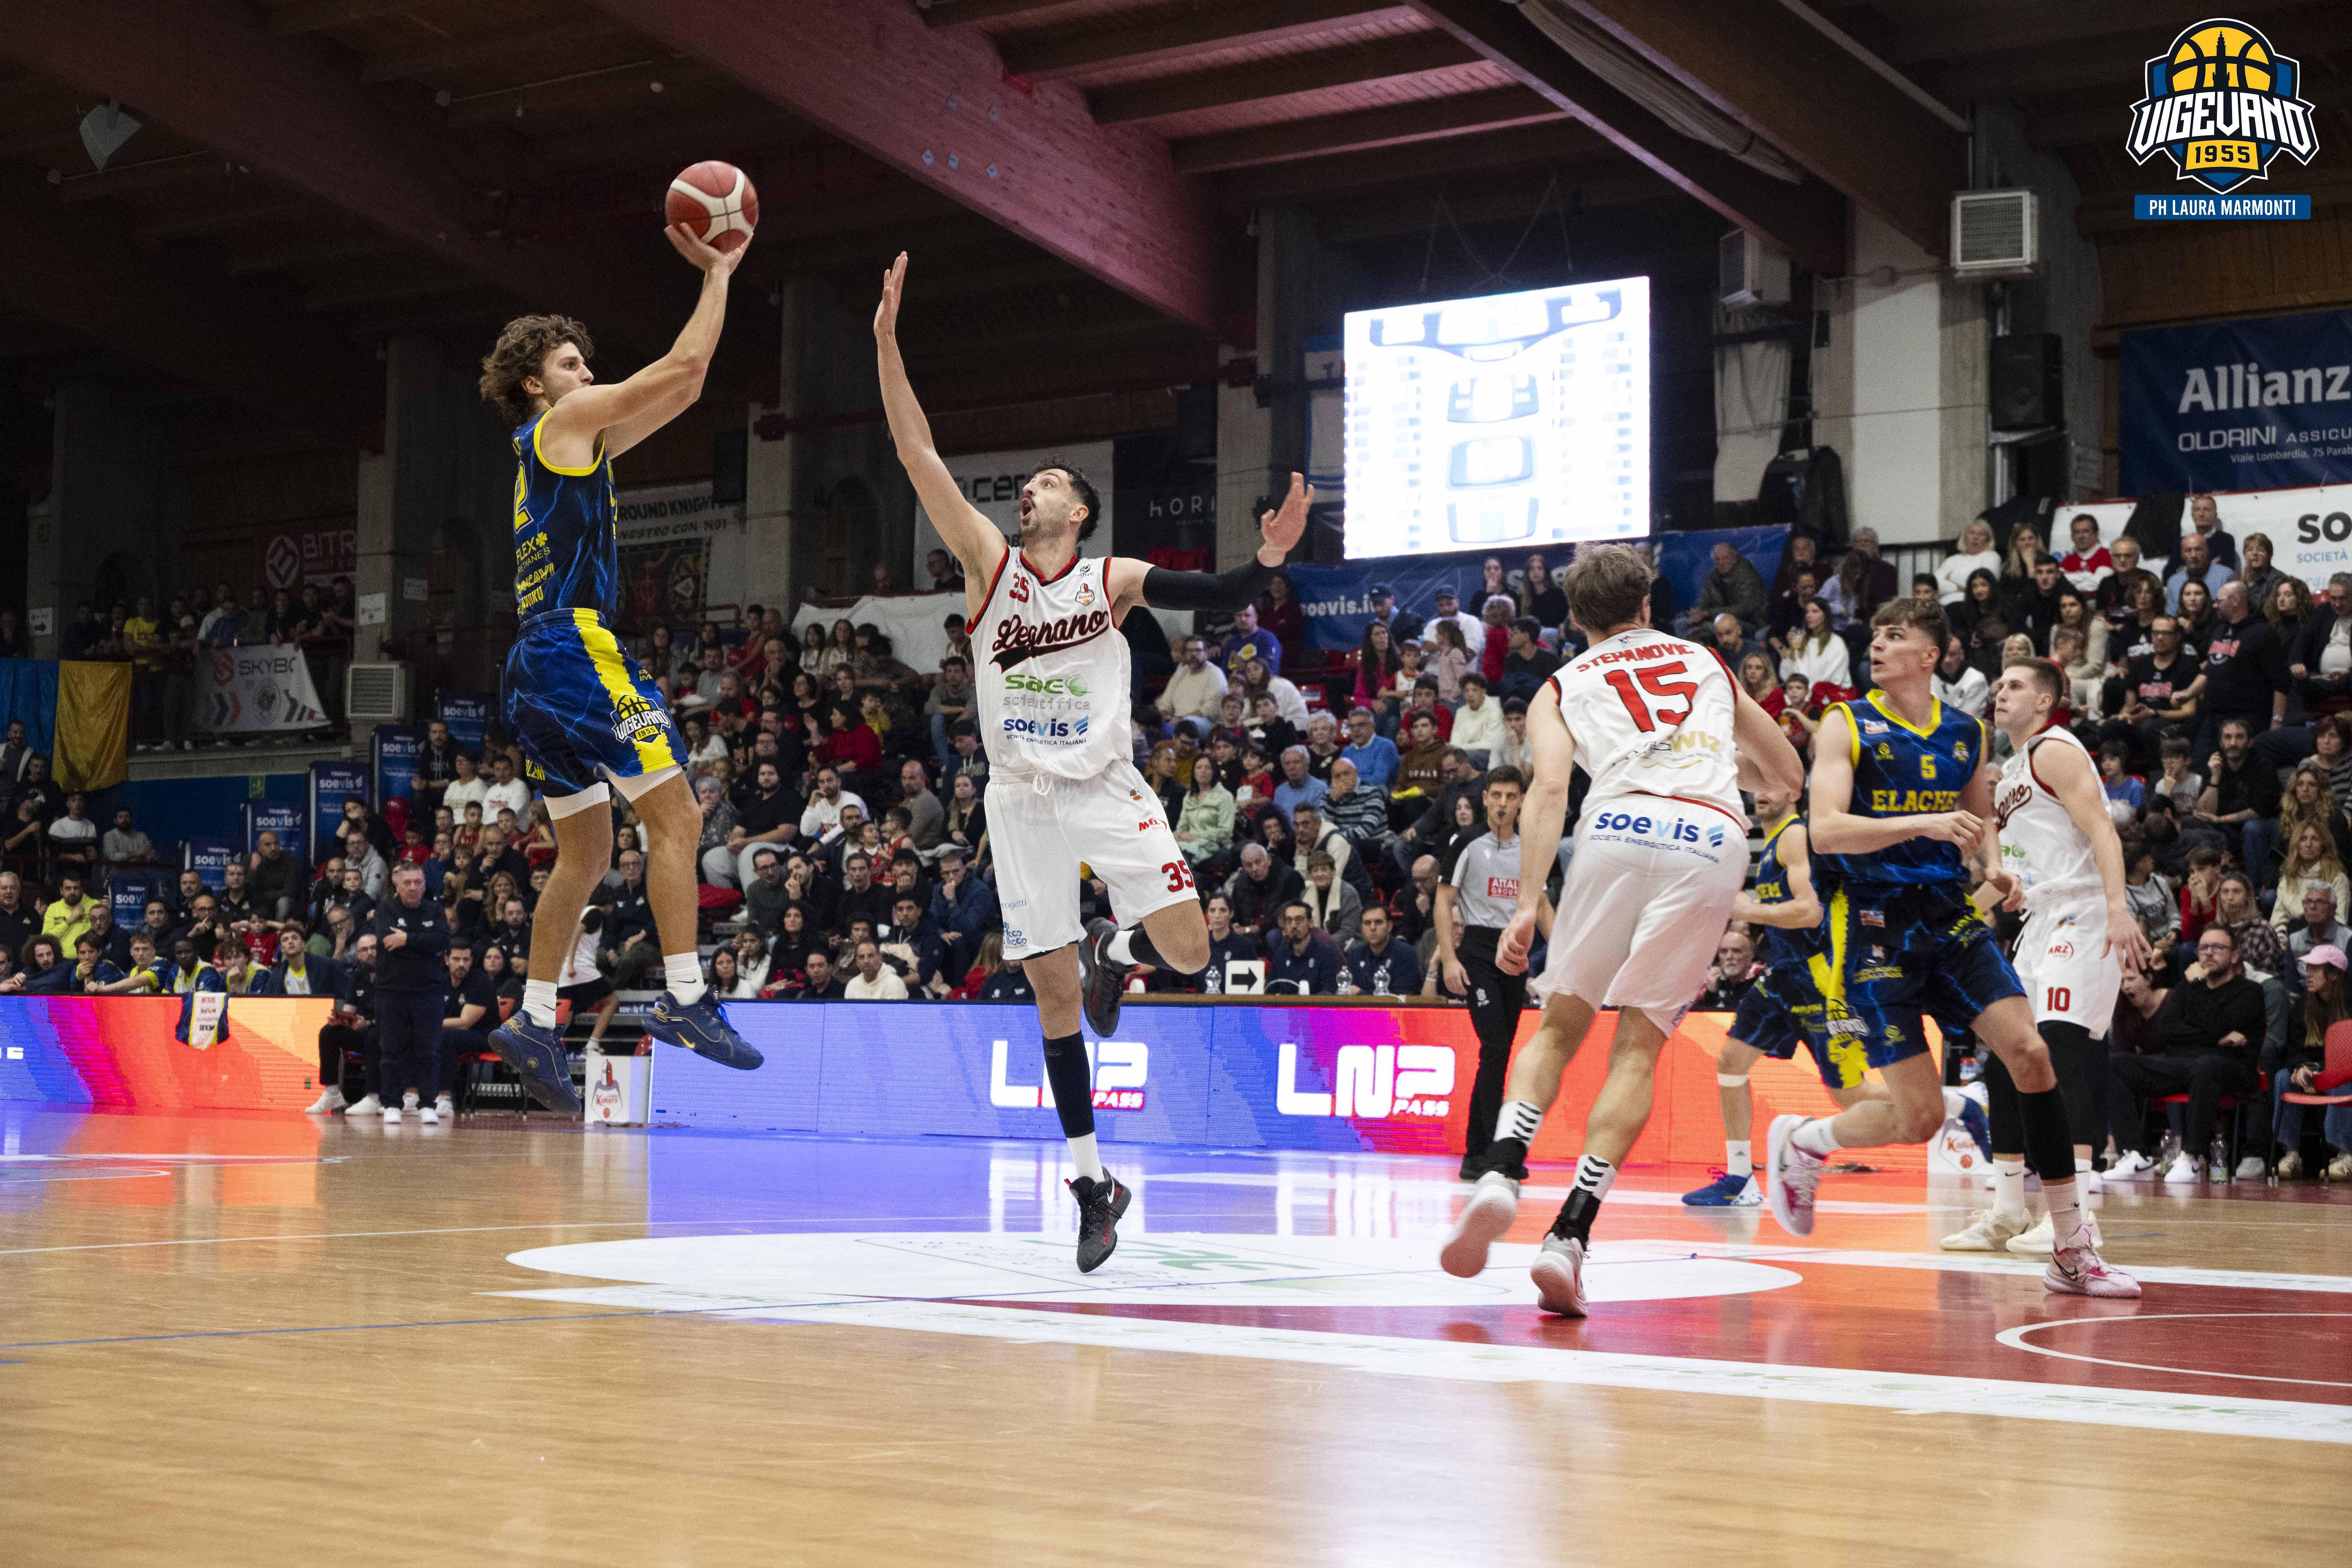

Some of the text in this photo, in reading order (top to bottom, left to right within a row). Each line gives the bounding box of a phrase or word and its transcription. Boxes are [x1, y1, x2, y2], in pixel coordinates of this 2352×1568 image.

[2178, 362, 2351, 414] Allianz
[2178, 426, 2277, 452] OLDRINI
[516, 536, 537, 565] FLEX
[1009, 572, 1029, 603] 35
[993, 610, 1109, 658] Legnano
[1576, 644, 1695, 672] STEPANOVIC
[1603, 661, 1699, 733] 15
[637, 727, 656, 738] 1955
[1003, 718, 1069, 737] soevis
[1920, 754, 1937, 780] 5
[318, 778, 354, 789] soevis
[256, 815, 295, 827] soevis
[1595, 812, 1700, 842] soevis
[1161, 859, 1194, 892] 35
[2047, 987, 2071, 1012] 10
[1276, 1043, 1456, 1118] LNP
[1092, 1091, 1144, 1109] PASS
[1392, 1099, 1450, 1117] PASS
